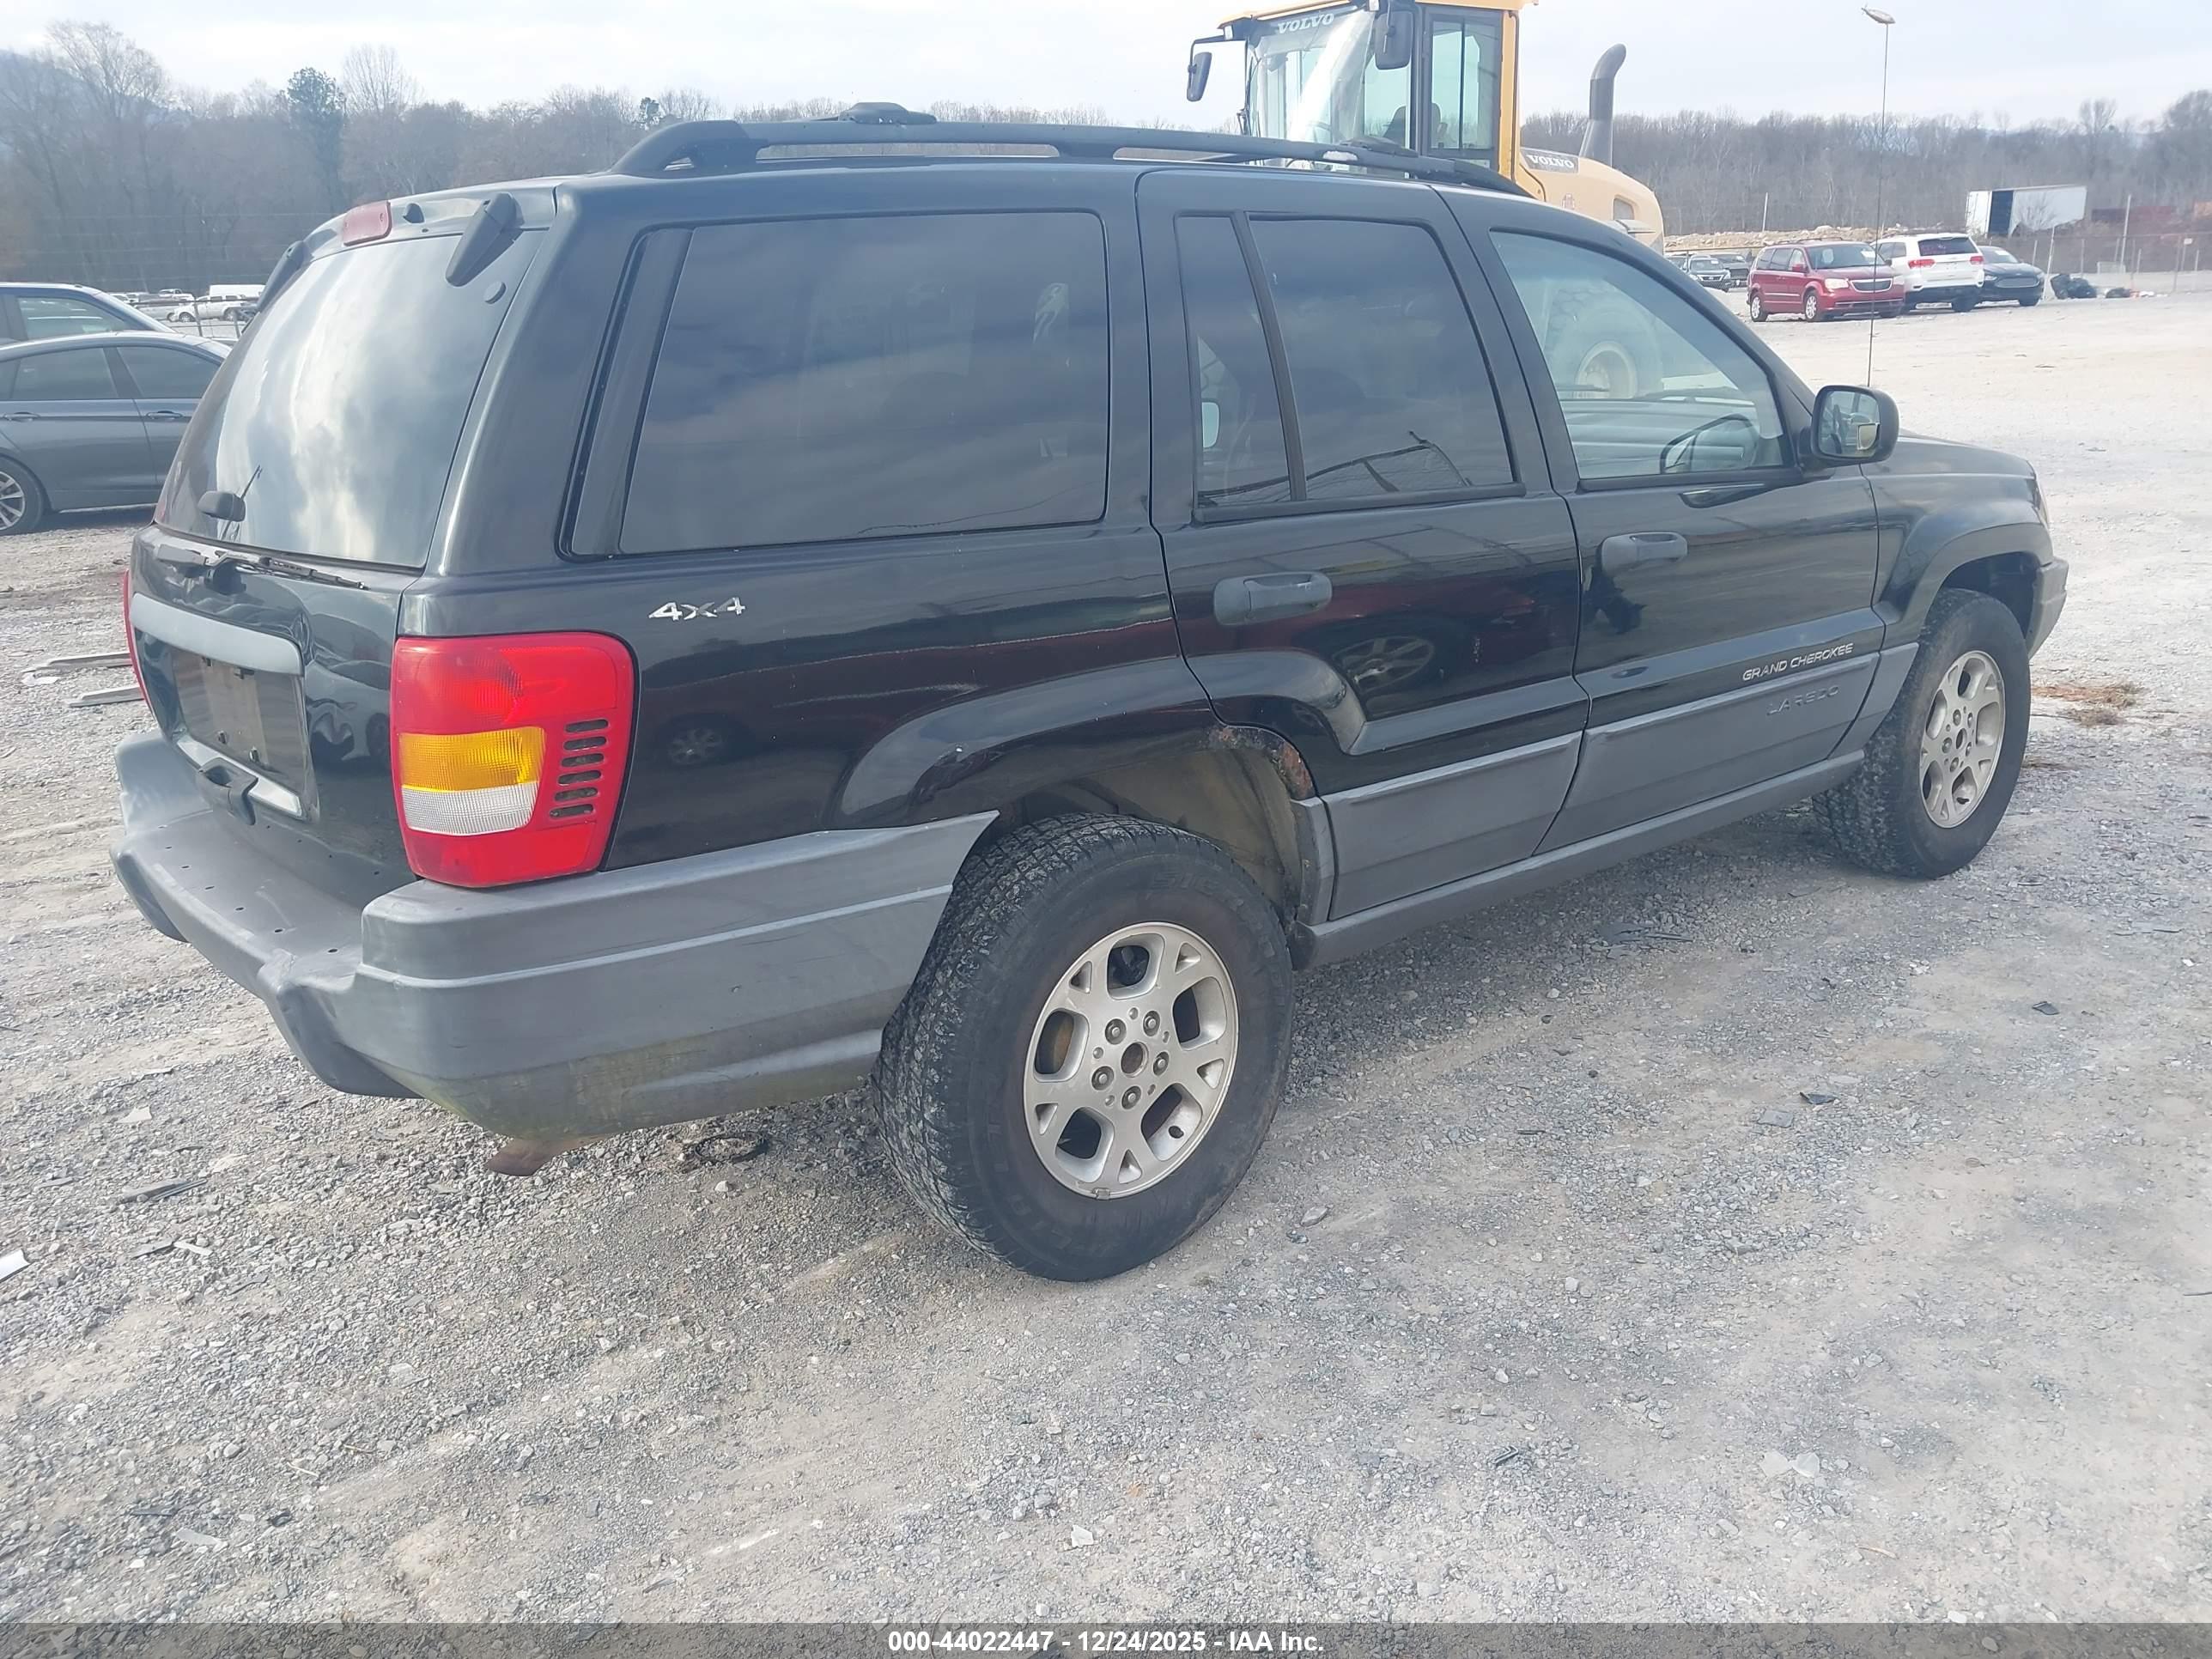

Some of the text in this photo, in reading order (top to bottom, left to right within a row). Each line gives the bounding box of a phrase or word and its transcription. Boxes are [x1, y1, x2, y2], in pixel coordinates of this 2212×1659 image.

[1277, 13, 1334, 34] VOLVO
[1526, 155, 1575, 169] VOLVO
[1742, 642, 1854, 681] GRAND CHEROKEE
